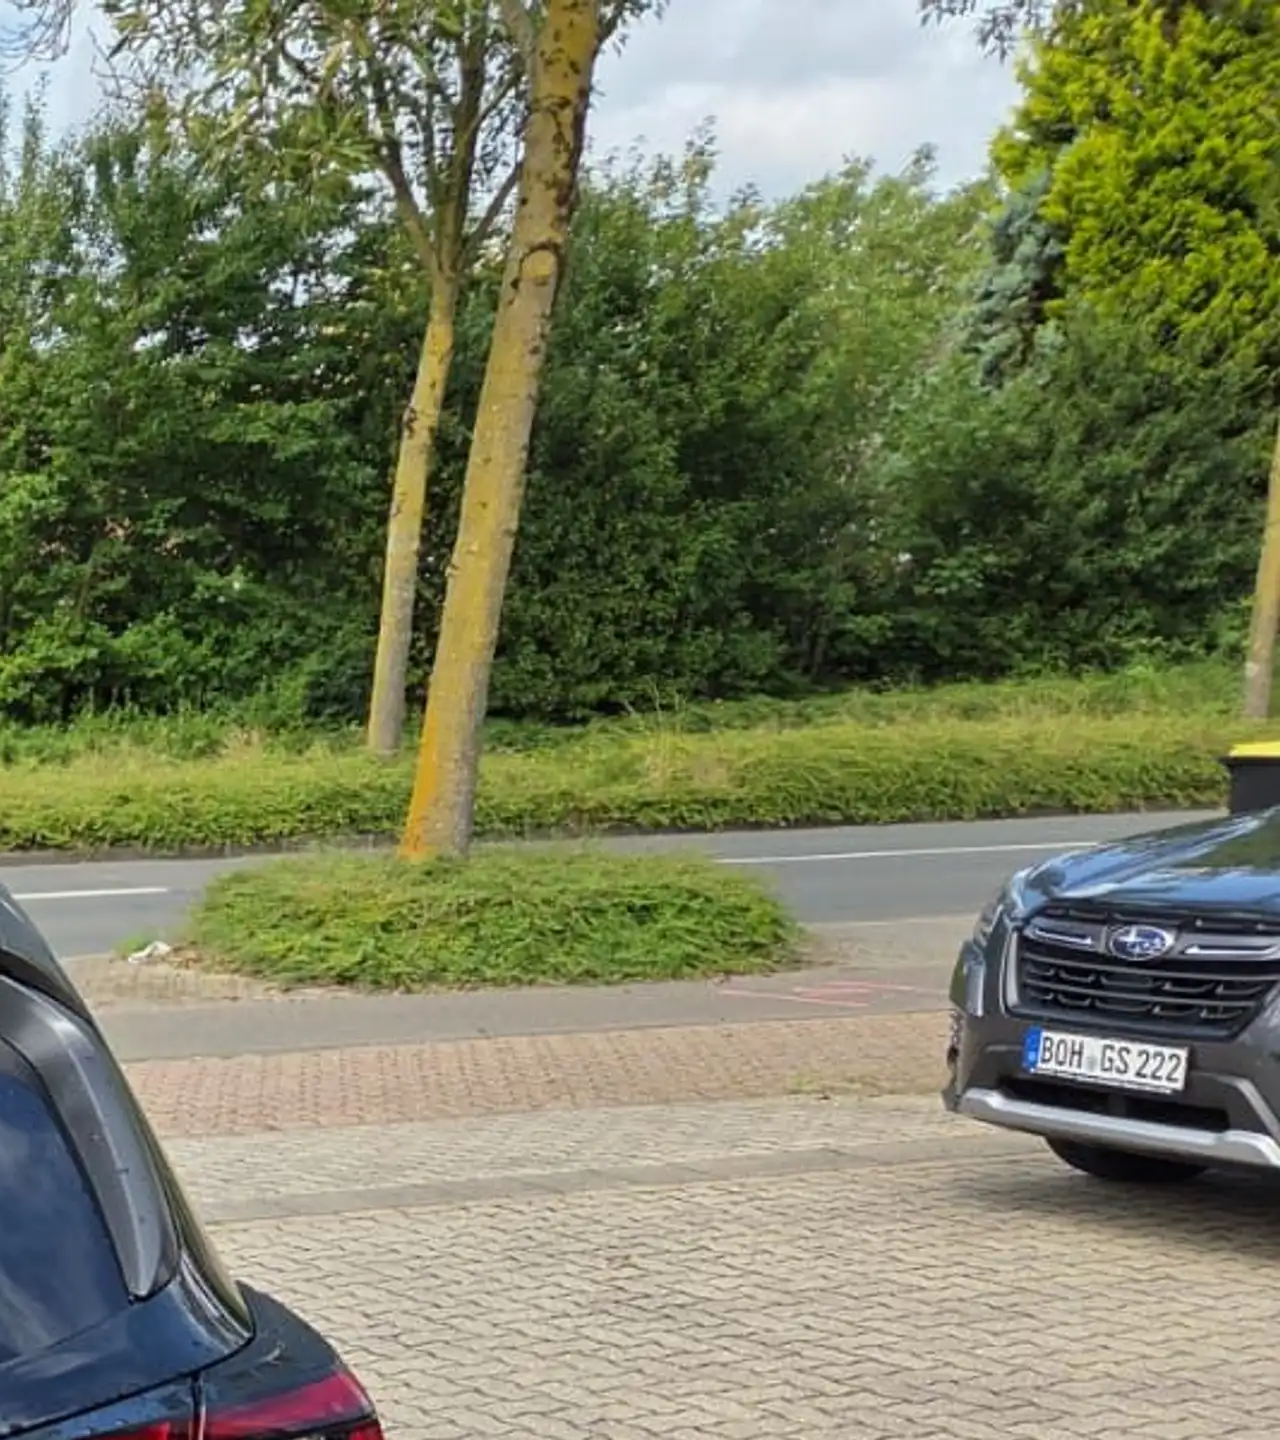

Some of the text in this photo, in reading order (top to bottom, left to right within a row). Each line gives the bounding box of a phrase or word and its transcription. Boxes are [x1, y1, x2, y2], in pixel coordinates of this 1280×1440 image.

[1041, 1036, 1182, 1084] BOH GS 222
